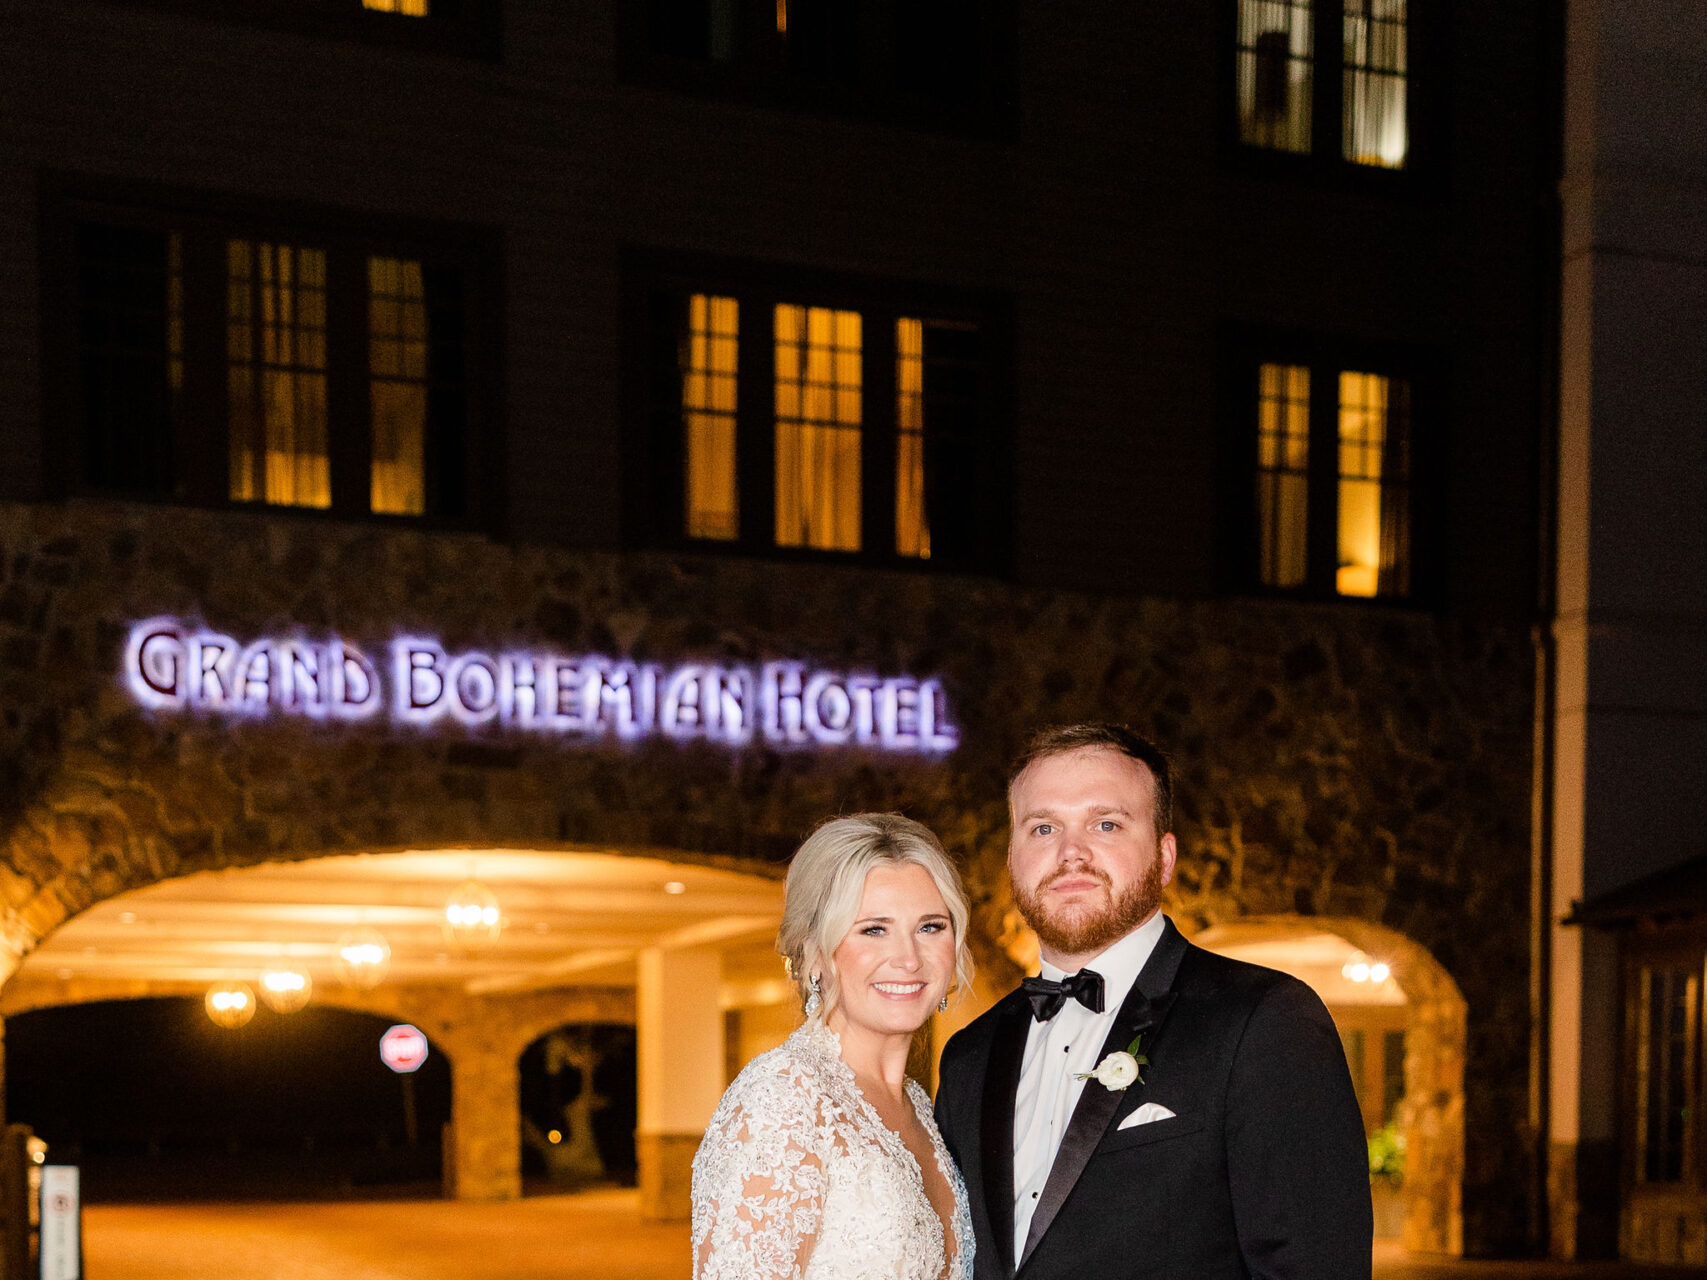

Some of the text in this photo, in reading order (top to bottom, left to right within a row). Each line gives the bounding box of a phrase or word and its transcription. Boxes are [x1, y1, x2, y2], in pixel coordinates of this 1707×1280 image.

[126, 619, 960, 753] GRAND BOHEMIAN HOTEL
